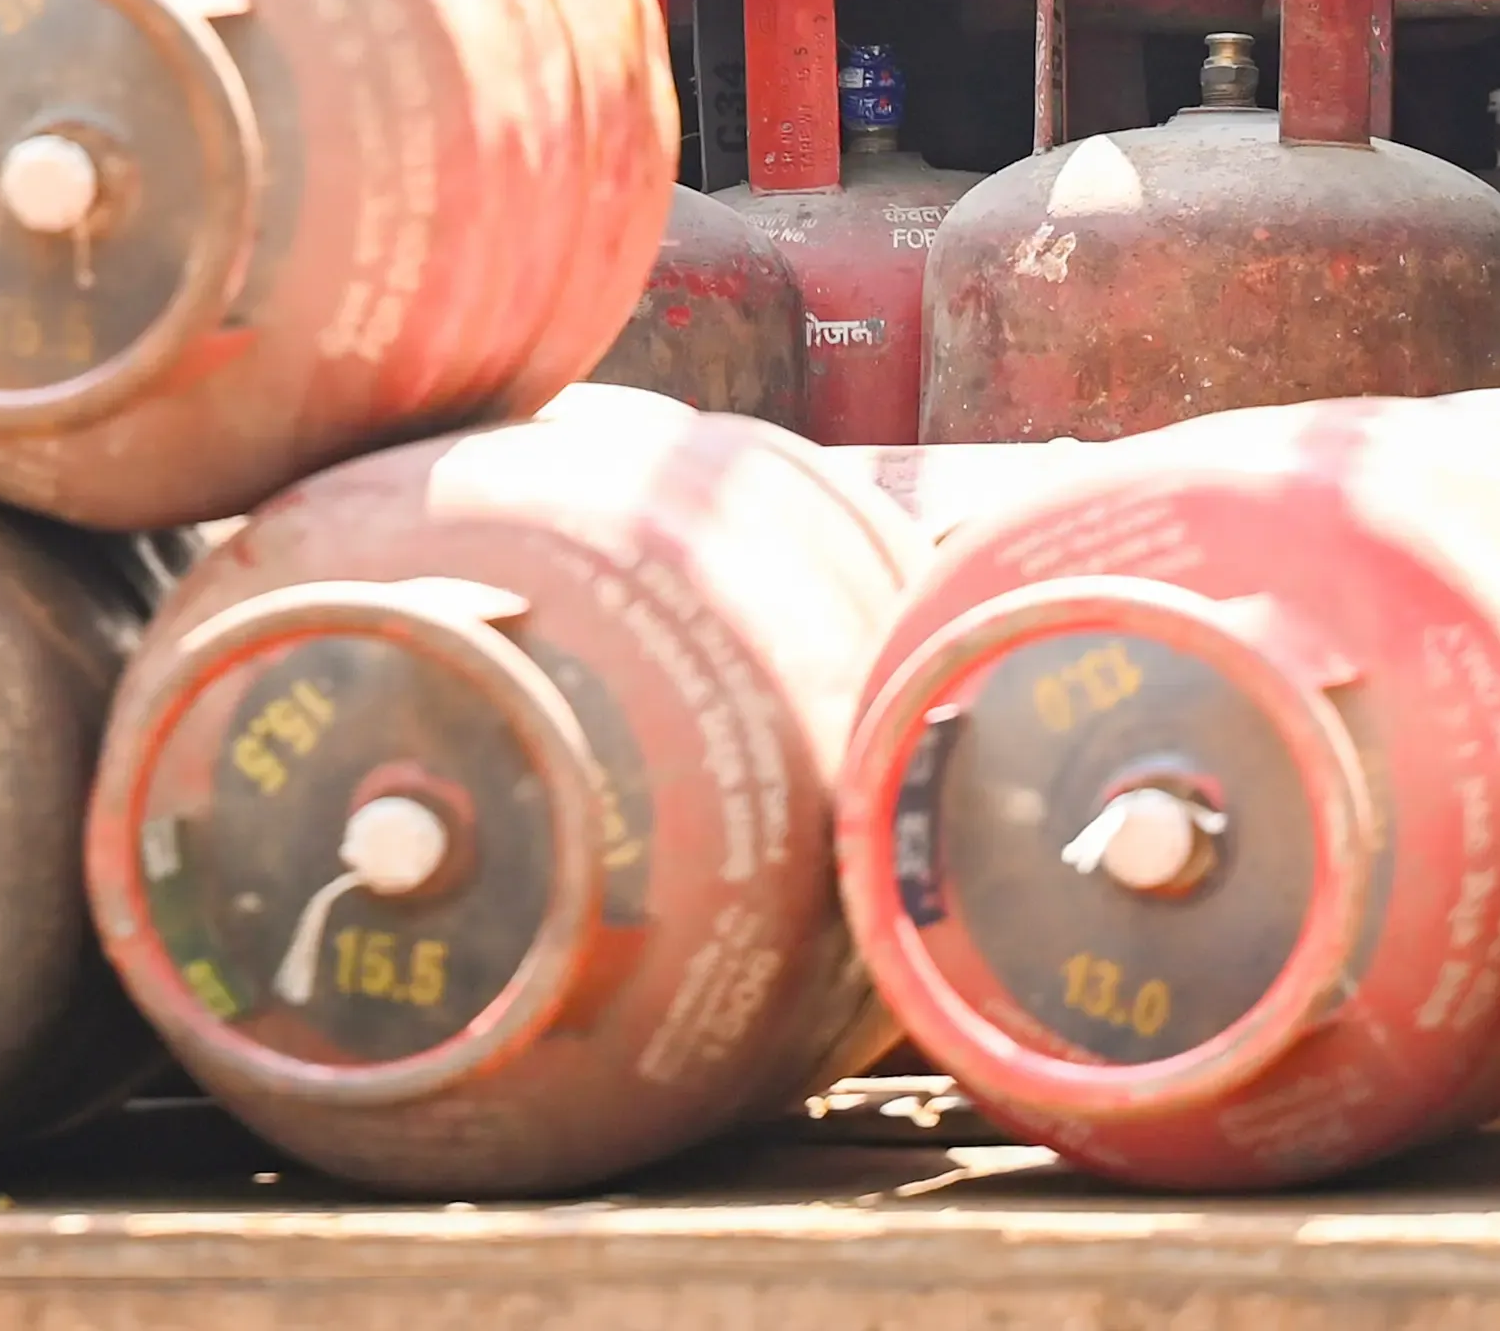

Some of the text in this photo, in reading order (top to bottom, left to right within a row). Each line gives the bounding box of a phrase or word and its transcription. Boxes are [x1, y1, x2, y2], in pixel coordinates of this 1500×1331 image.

[232, 680, 339, 799] 15.5
[332, 928, 449, 1008] 15.5
[1059, 951, 1170, 1039] 13.0
